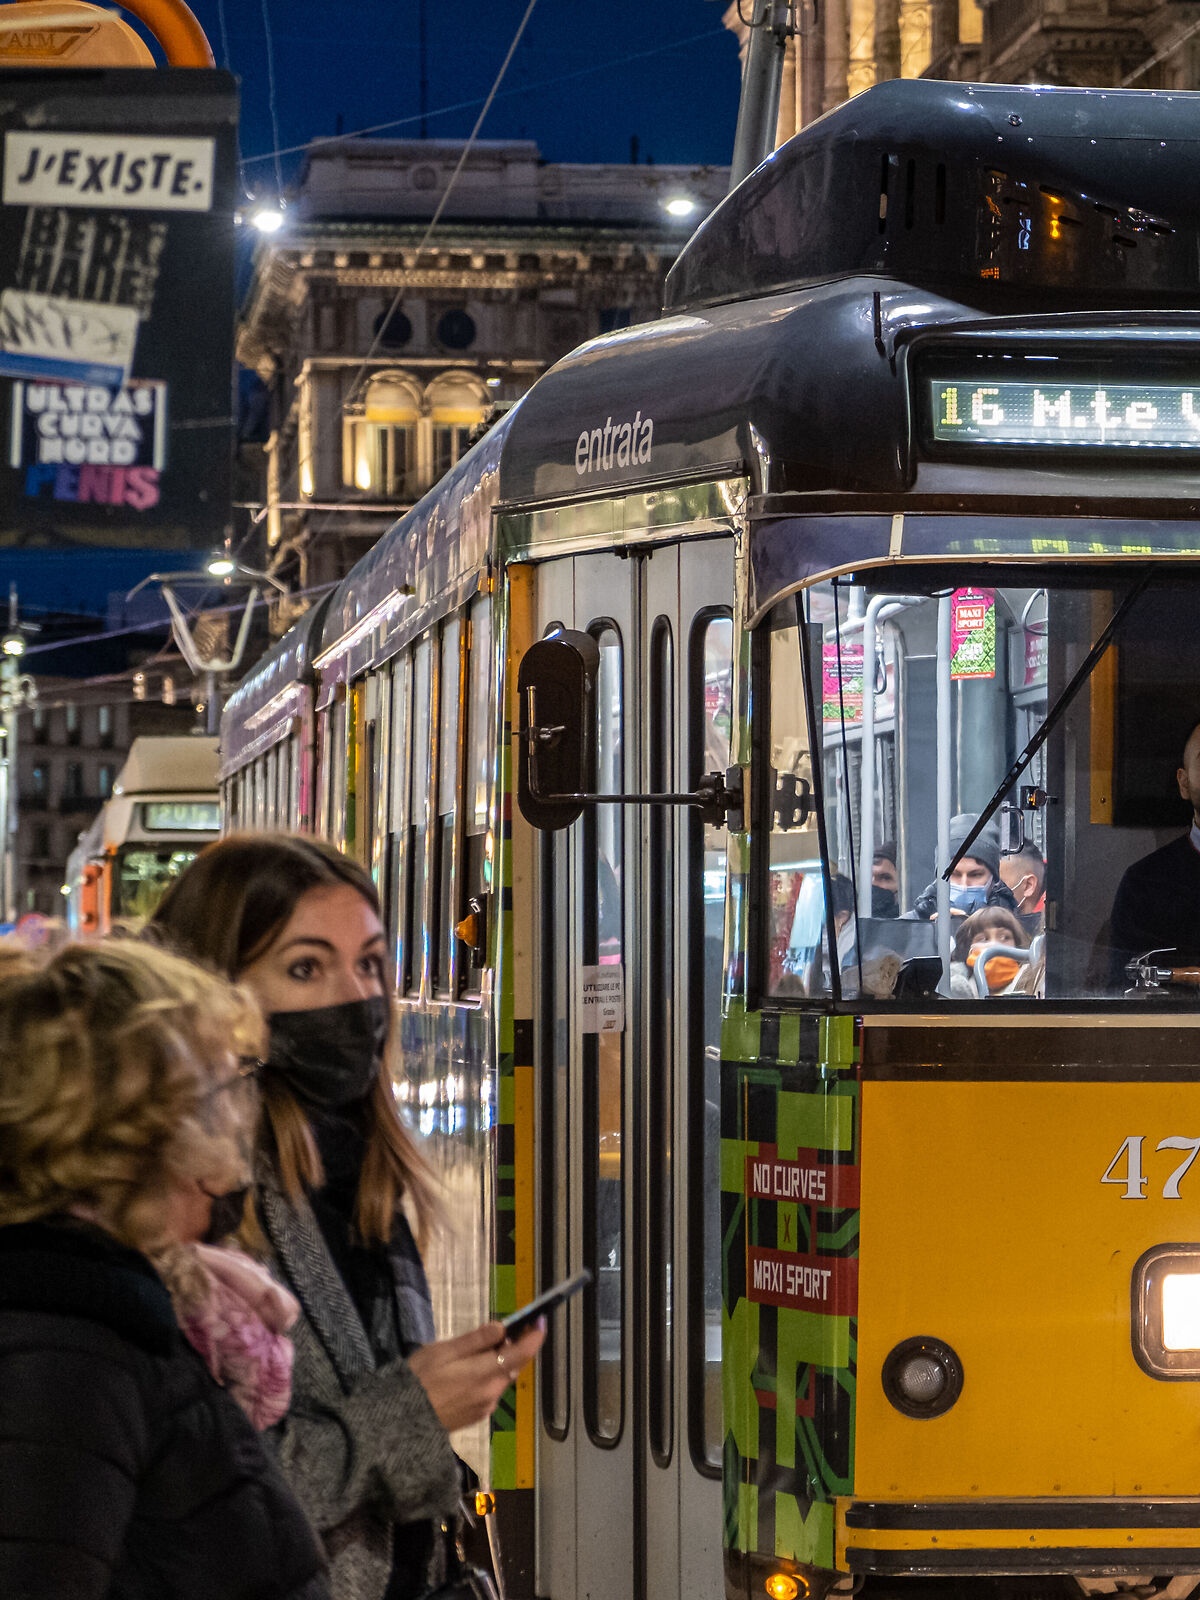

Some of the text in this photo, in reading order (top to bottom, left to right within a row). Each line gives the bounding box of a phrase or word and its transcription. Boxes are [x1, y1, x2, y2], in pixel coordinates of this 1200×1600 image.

[7, 32, 56, 48] ATM
[18, 148, 203, 196] J'EXISTE.
[26, 385, 152, 415] ULTRAS
[941, 387, 1004, 425] 16
[1033, 389, 1158, 429] M.te
[38, 412, 142, 440] CURVA
[575, 410, 654, 475] entrata
[39, 437, 137, 465] NORD
[25, 463, 160, 510] PENIS
[957, 619, 983, 628] SPORT
[959, 609, 982, 618] MAXI
[753, 1162, 826, 1202] NO CURVES
[753, 1259, 832, 1301] MAXI SPORT
